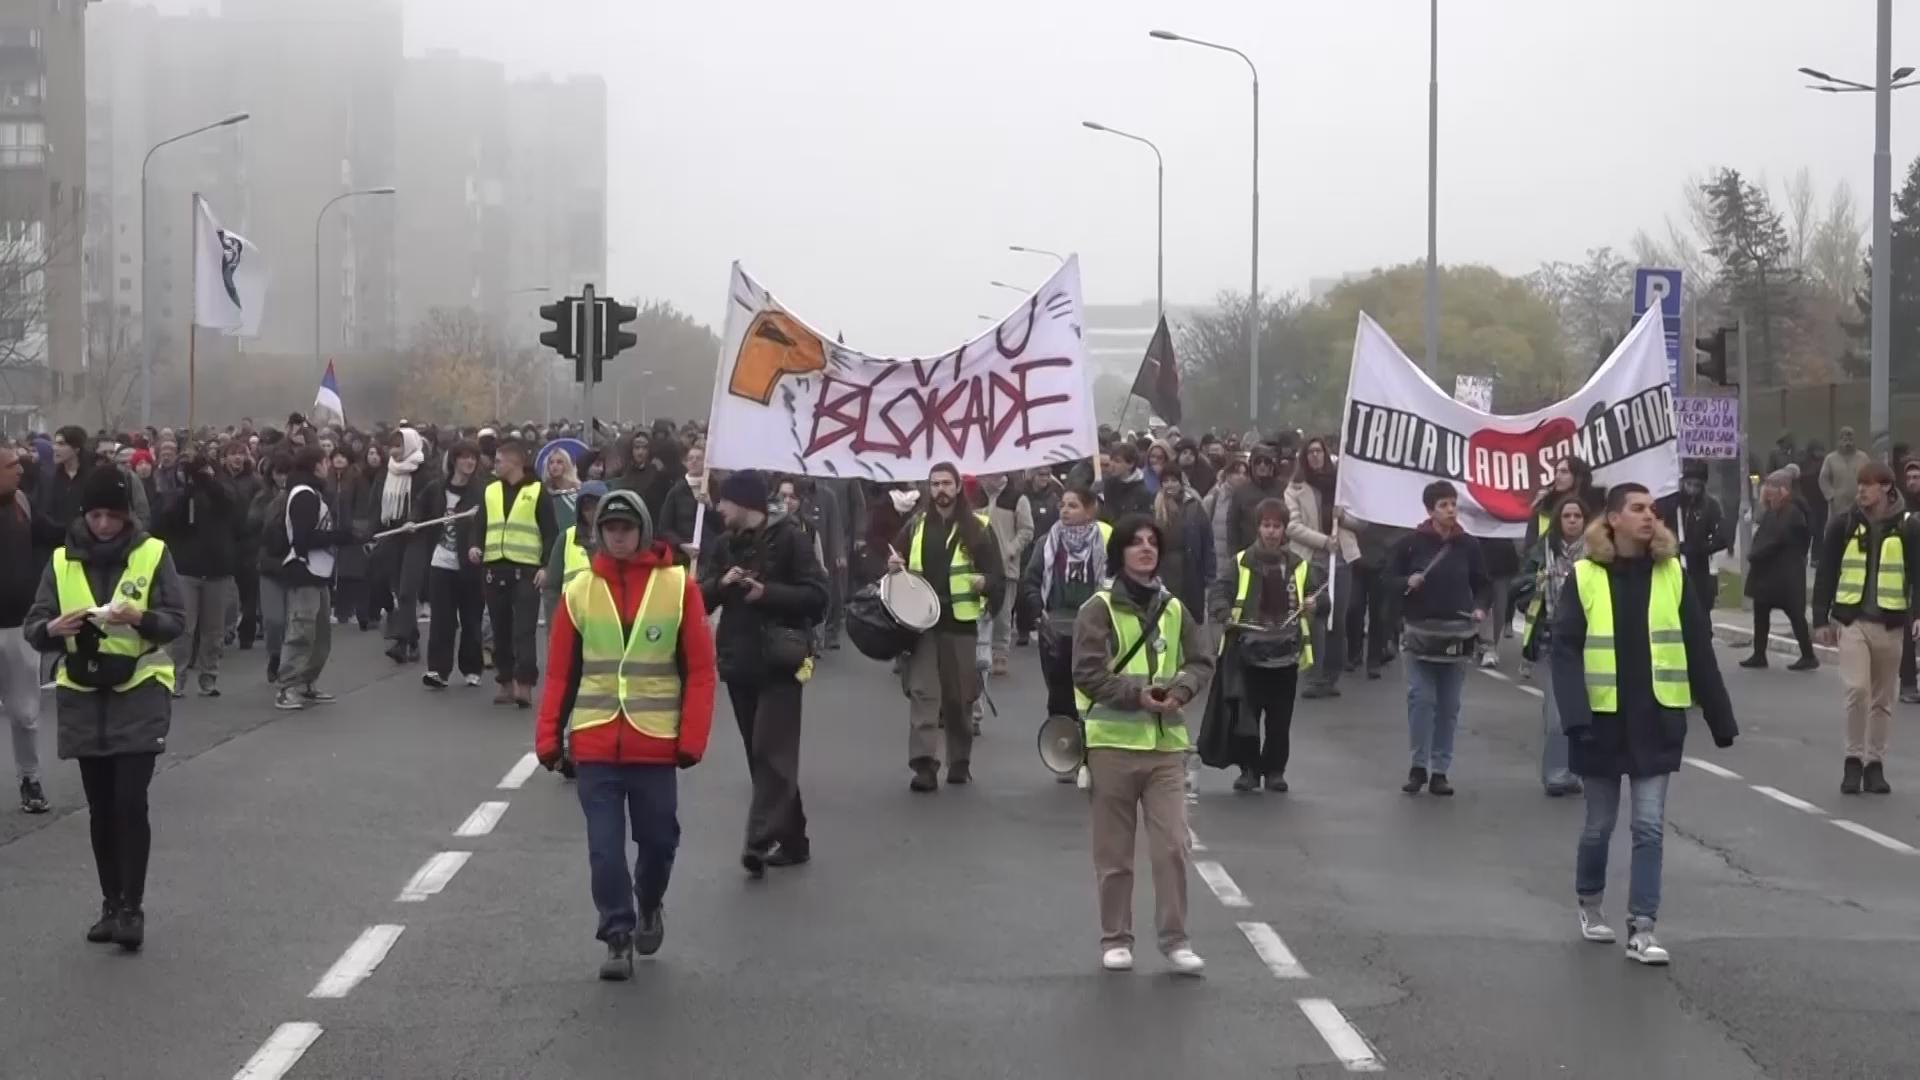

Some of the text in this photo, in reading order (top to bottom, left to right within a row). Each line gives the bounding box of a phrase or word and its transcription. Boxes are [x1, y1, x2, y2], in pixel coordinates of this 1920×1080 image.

[1645, 275, 1671, 308] P
[802, 357, 1074, 462] BLOKADE
[1356, 404, 1437, 470] TRULA
[1446, 433, 1530, 490] VLADA
[1614, 385, 1677, 459] PADA
